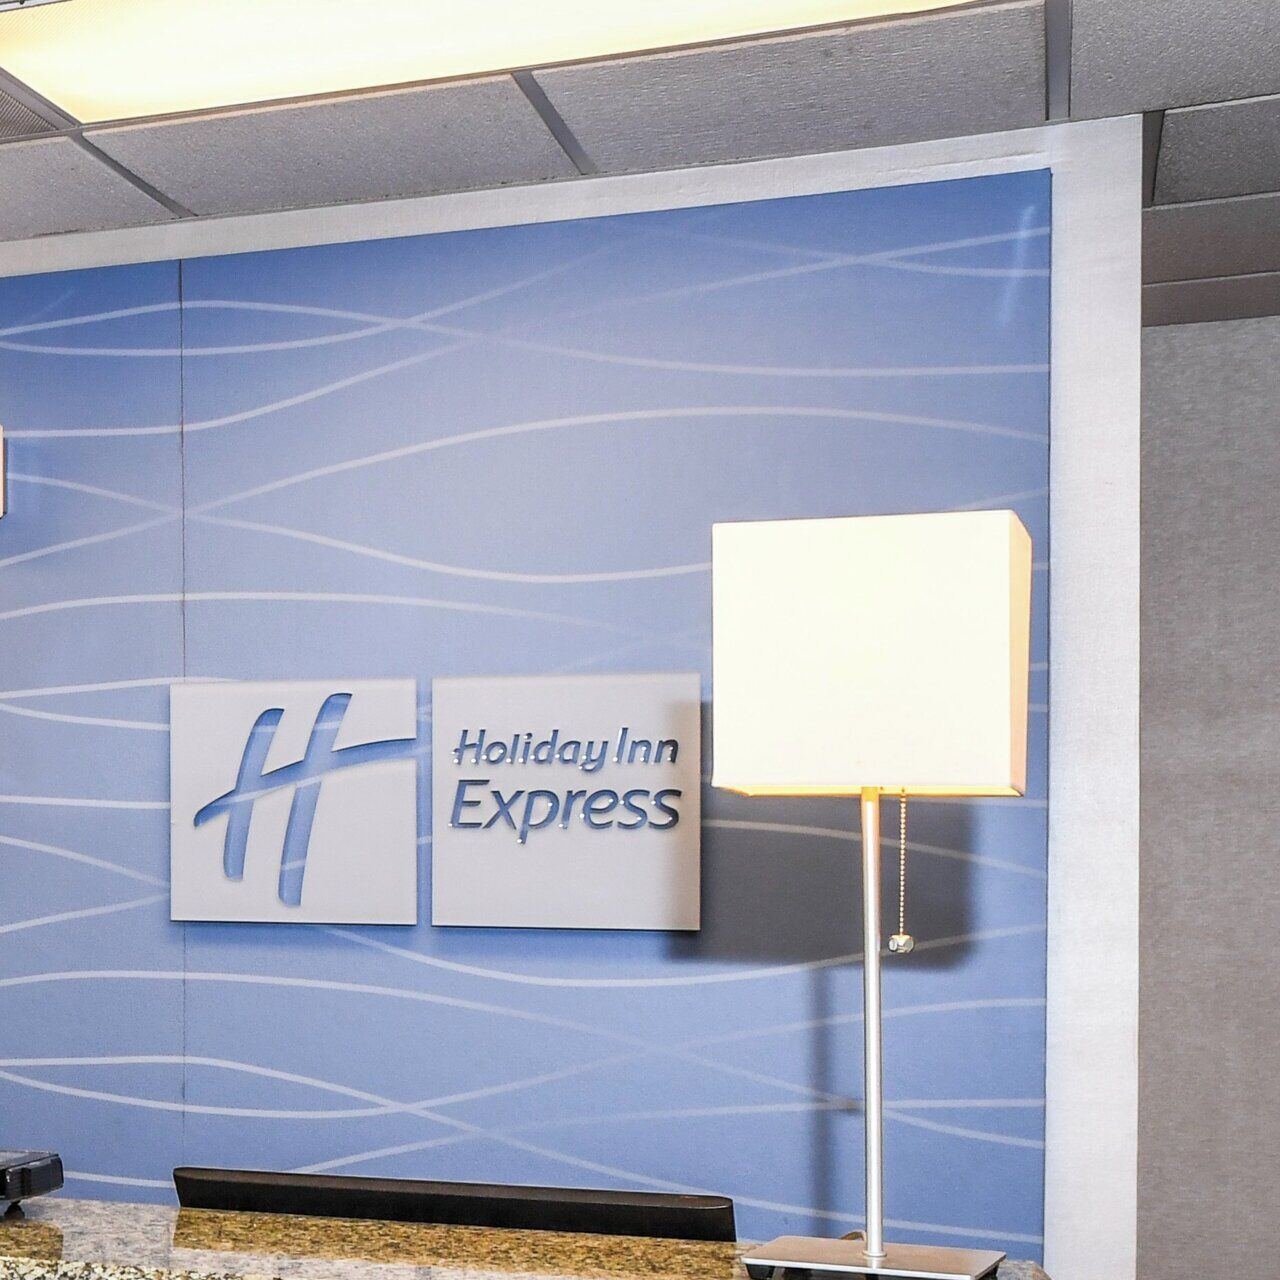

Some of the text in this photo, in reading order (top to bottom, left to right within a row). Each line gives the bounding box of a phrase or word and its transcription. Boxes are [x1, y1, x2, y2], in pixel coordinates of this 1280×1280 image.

[451, 727, 680, 772] Holiday Inn
[447, 779, 683, 845] Express
